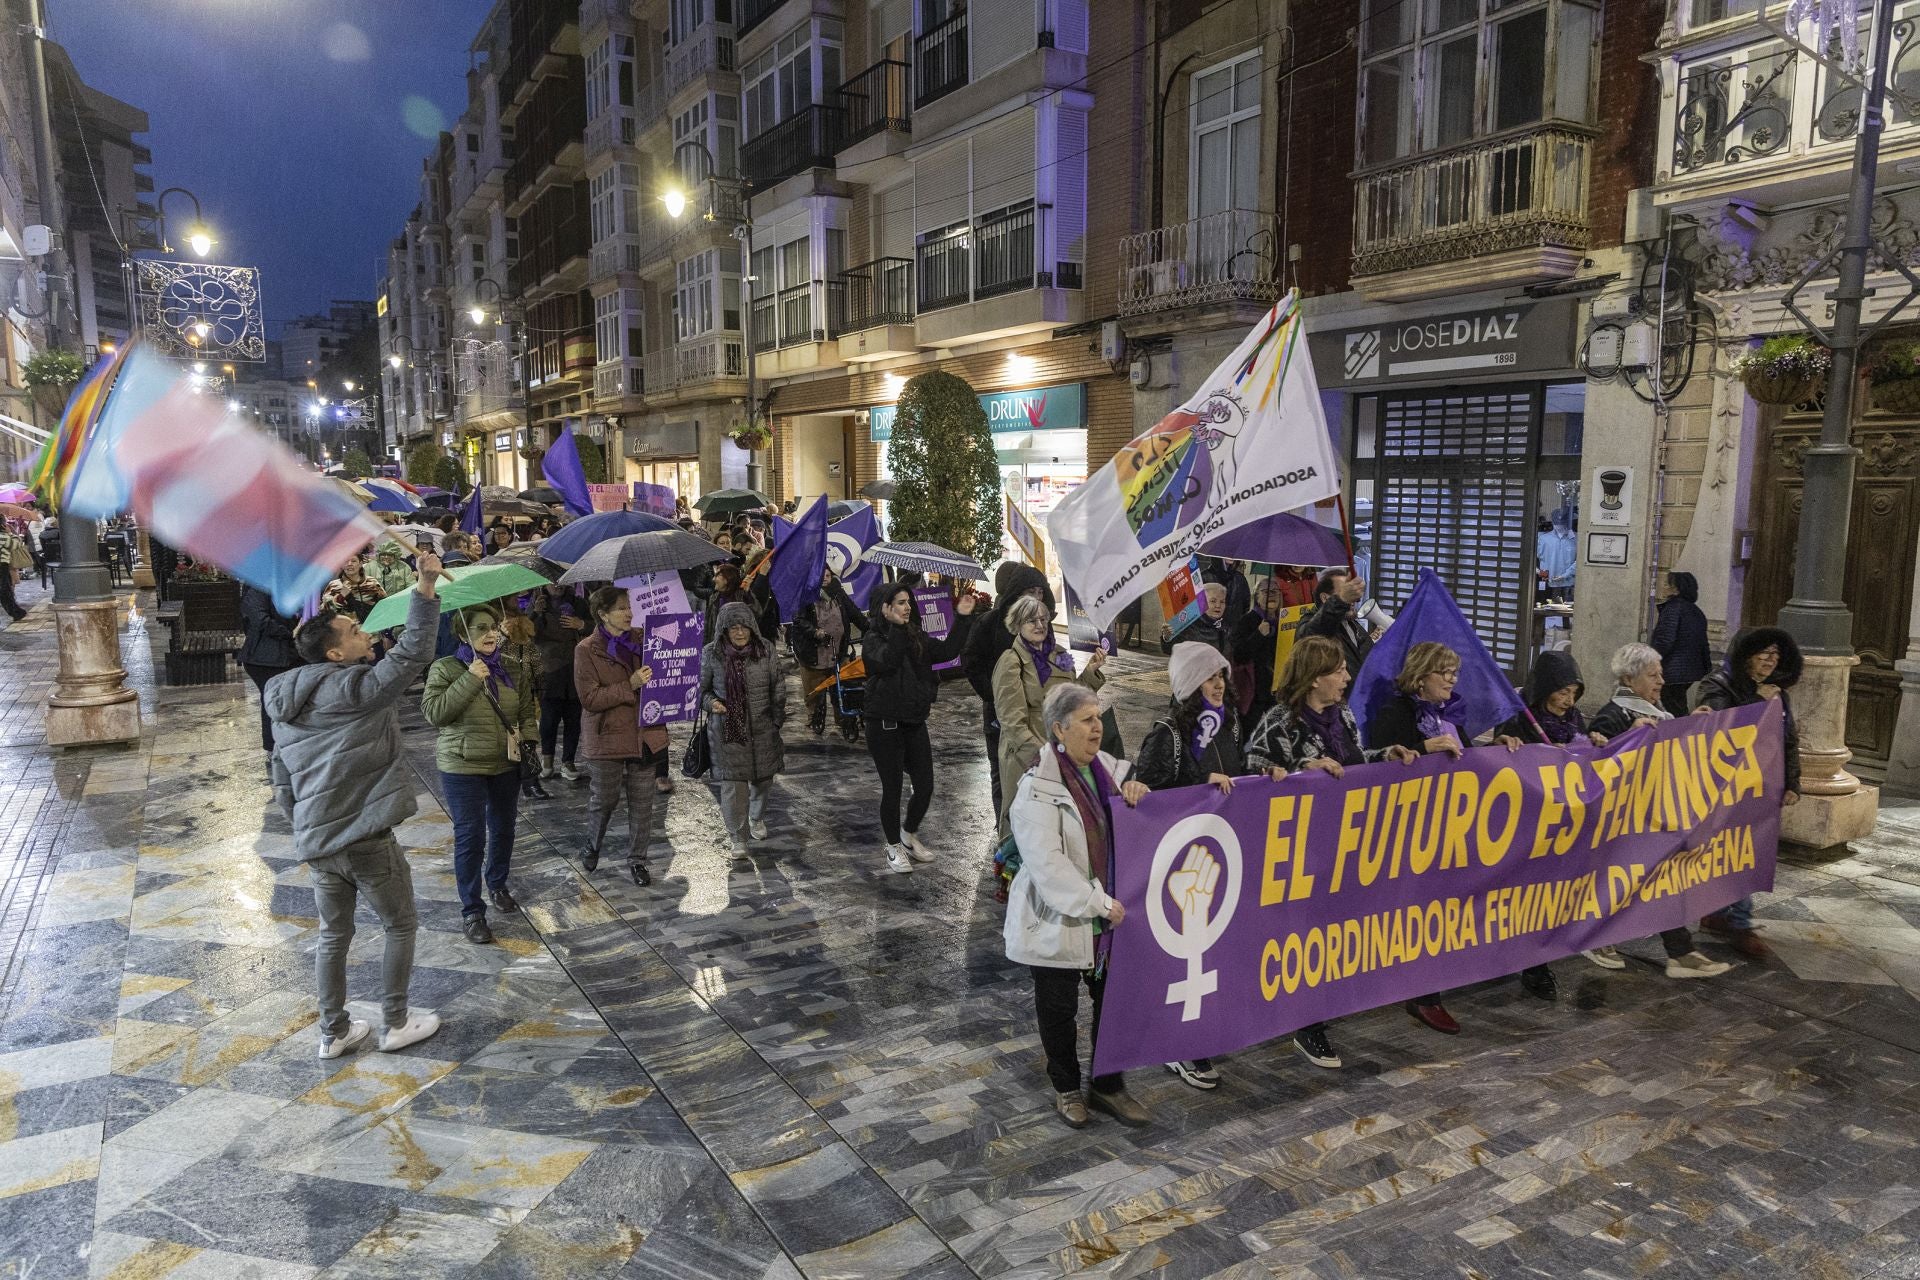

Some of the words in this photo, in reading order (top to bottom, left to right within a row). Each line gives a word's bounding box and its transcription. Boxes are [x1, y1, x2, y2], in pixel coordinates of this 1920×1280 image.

[1494, 353, 1515, 365] 1898
[653, 650, 672, 660] ACCIÓN
[673, 648, 698, 659] FEMINISTA
[668, 658, 686, 668] TOCAN
[672, 668, 681, 676] UNA
[659, 678, 676, 688] TOCAN
[1260, 795, 1315, 906] EL
[1329, 767, 1523, 894] FUTURO
[1529, 761, 1586, 859] ES
[1260, 895, 1478, 1002] COORDINADORA
[1485, 871, 1602, 944] FEMINISTA
[1608, 863, 1646, 916] DE
[1639, 824, 1756, 903] CARTAGENA
